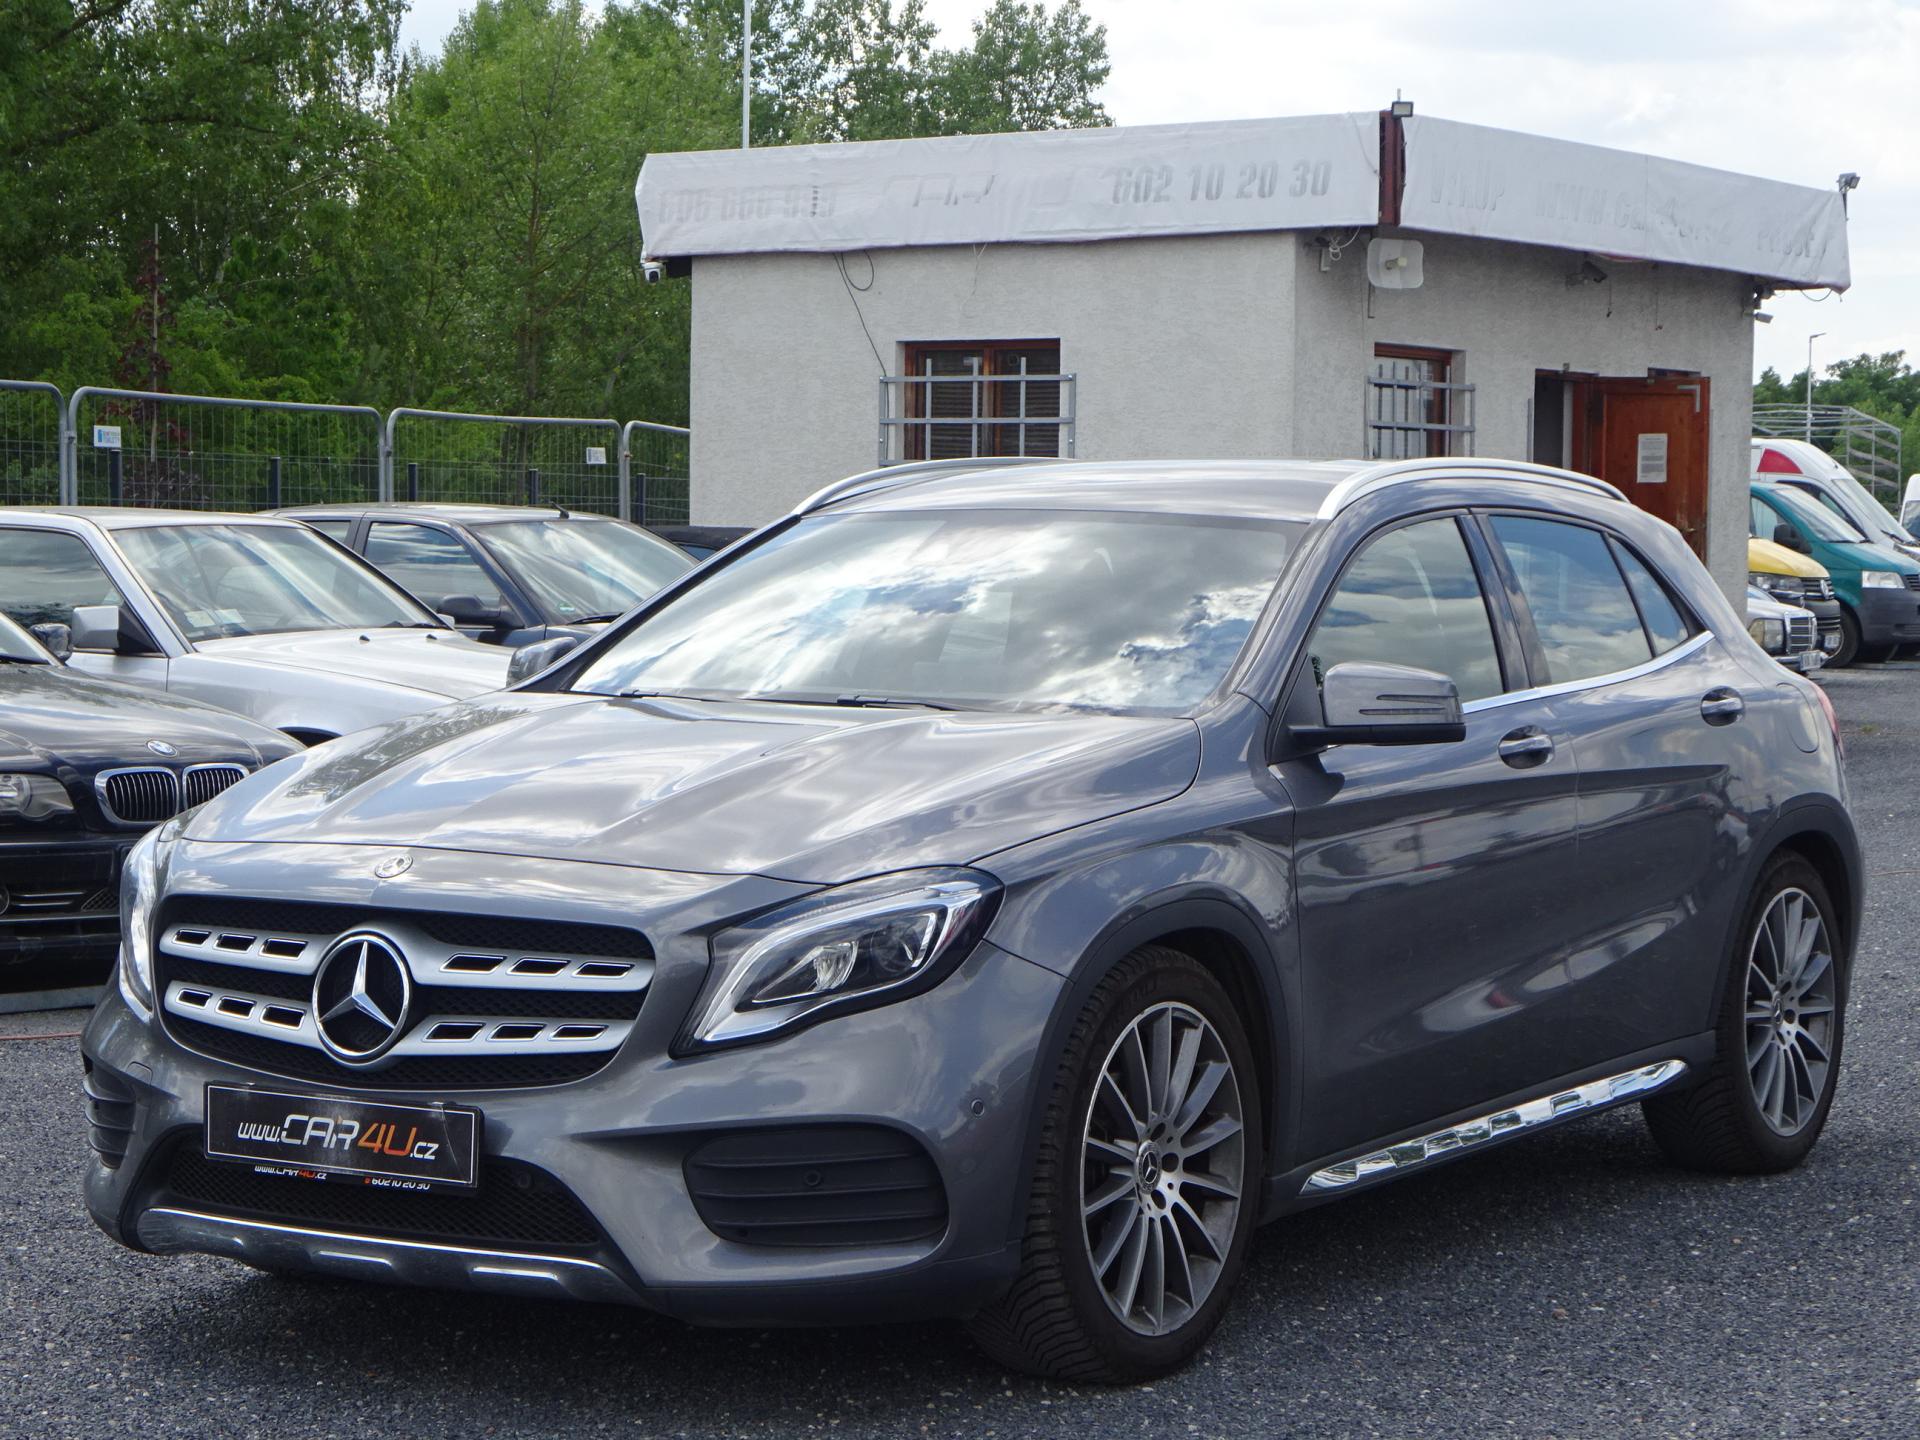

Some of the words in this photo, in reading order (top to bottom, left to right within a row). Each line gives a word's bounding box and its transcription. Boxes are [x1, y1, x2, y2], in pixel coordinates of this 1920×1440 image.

[1188, 162, 1225, 201] 10
[1236, 160, 1279, 200] 20
[1289, 158, 1333, 197] 30
[237, 1114, 439, 1160] www.CAR4U.cz
